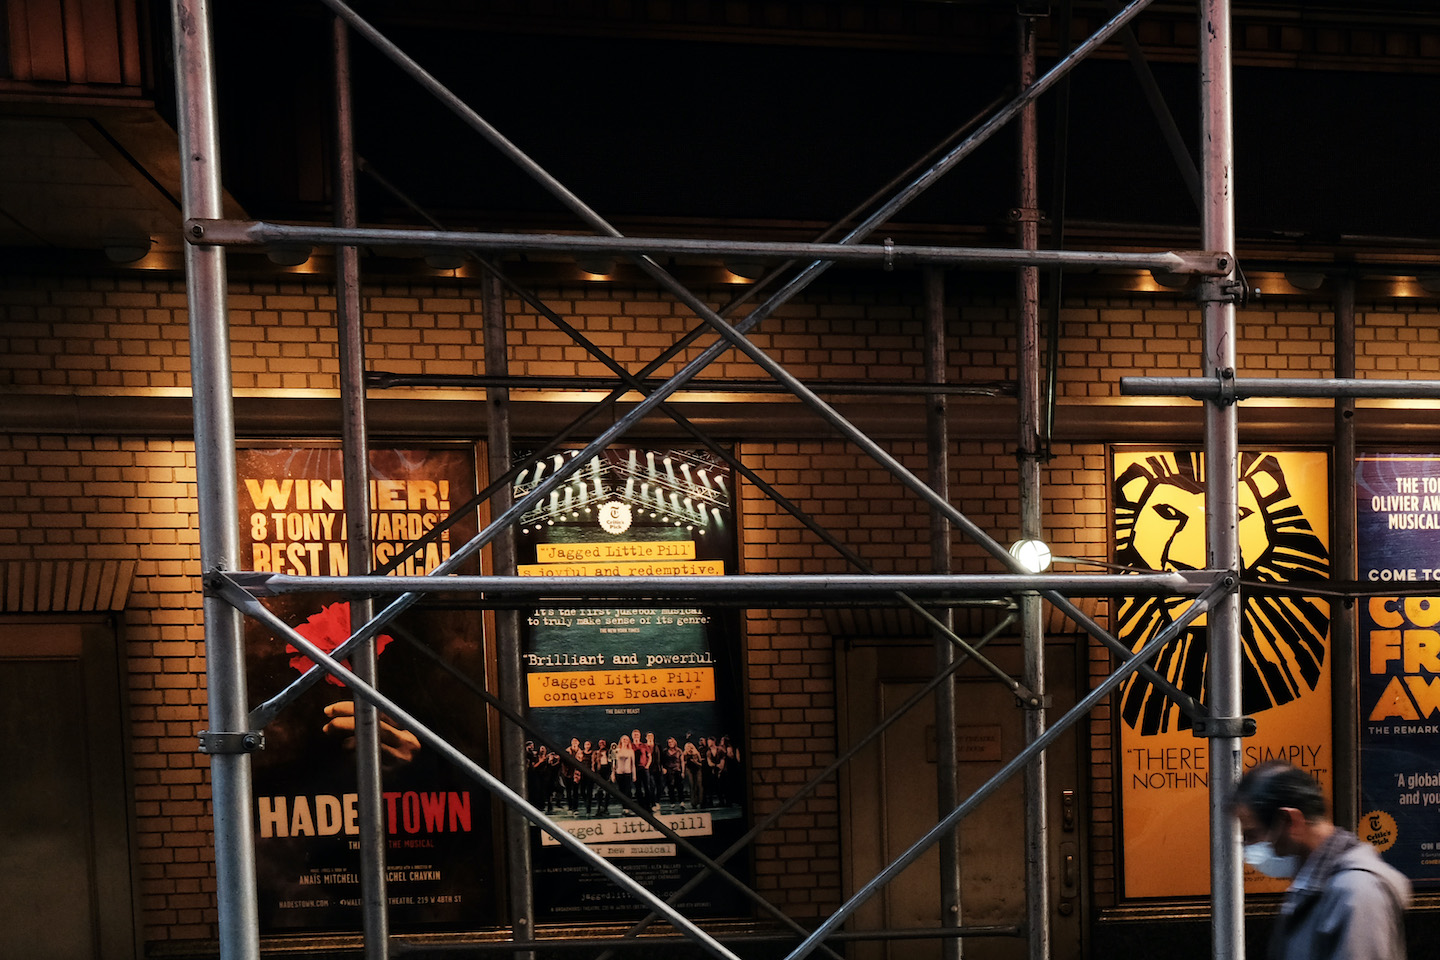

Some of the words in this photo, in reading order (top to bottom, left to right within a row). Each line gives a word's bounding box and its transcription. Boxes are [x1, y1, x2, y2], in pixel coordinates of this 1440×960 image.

[1396, 478, 1419, 493] THE
[244, 479, 450, 511] WINER!
[1372, 496, 1420, 512] OLIVIER
[250, 512, 267, 541] 8
[272, 512, 336, 541] TONY
[340, 512, 439, 541] ARDS
[1388, 513, 1440, 529] MUSICAL
[605, 545, 653, 557] Little
[252, 542, 323, 577] BEST
[328, 542, 458, 577] MSICAL
[594, 566, 620, 576] and
[629, 564, 720, 576] redemptive,
[1368, 568, 1417, 581] COME
[527, 617, 540, 627] to
[543, 617, 573, 628] truly
[576, 616, 602, 626] make
[605, 617, 636, 626] sense
[639, 616, 651, 625] of
[656, 616, 674, 626] its
[613, 654, 639, 665] and
[646, 652, 717, 667] powerful.
[605, 674, 658, 686] Little
[544, 690, 615, 703] conquers
[1368, 726, 1390, 735] THE
[1244, 745, 1322, 769] SIMPLY
[1133, 772, 1209, 789] NOTHIN
[1399, 791, 1420, 805] and
[258, 790, 472, 838] HADETOWN
[670, 816, 706, 831] pill
[388, 840, 402, 848] THE
[631, 846, 671, 854] musical
[323, 872, 359, 885] MITCHELL
[409, 870, 441, 881] CHAVKIN
